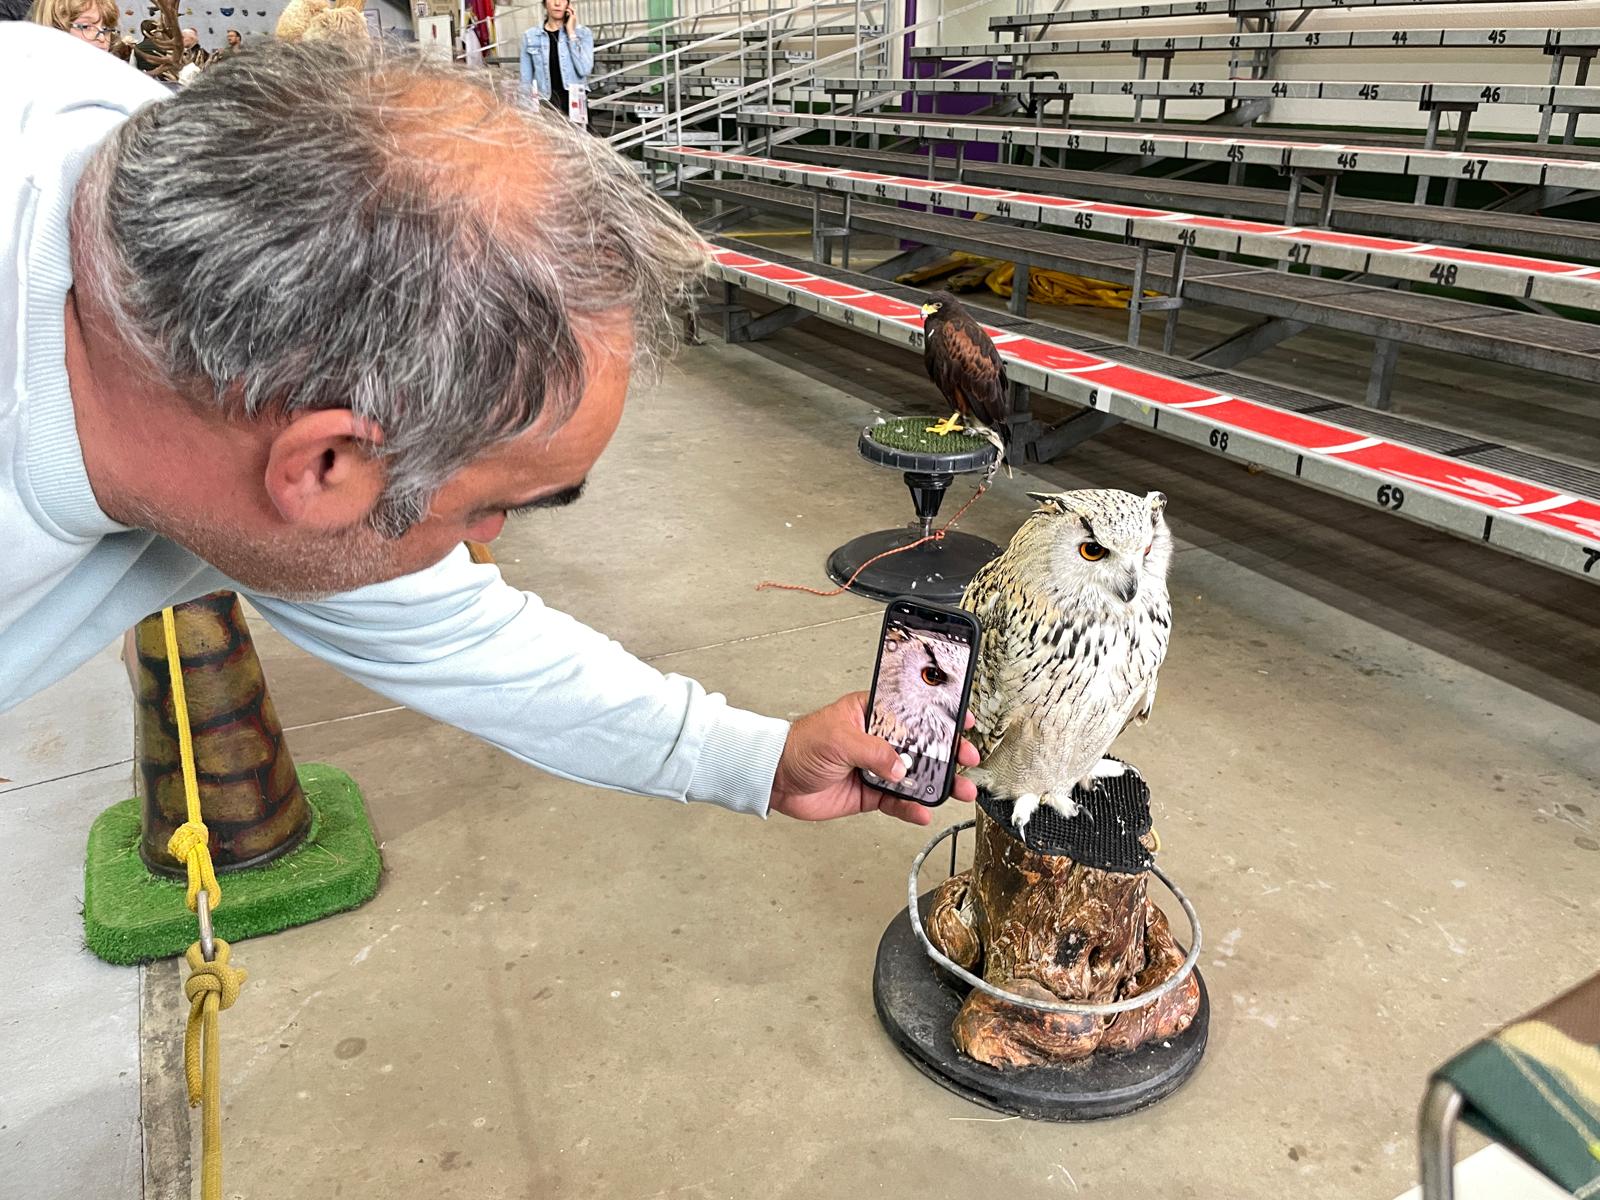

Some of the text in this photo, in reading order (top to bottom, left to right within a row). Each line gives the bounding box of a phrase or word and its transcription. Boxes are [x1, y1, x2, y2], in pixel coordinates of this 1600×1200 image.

[1195, 2, 1207, 13] 40
[1165, 38, 1175, 50] 41
[1229, 36, 1240, 47] 42
[1305, 33, 1320, 46] 43
[1392, 31, 1407, 45] 44
[1488, 30, 1506, 44] 45
[1058, 82, 1067, 93] 41
[1121, 82, 1133, 94] 42
[1189, 82, 1205, 96] 43
[1271, 82, 1287, 98] 44
[1358, 84, 1379, 100] 45
[1480, 86, 1500, 103] 46
[1002, 131, 1012, 143] 42
[1067, 135, 1080, 149] 43
[1140, 140, 1155, 155] 44
[1227, 144, 1245, 162] 45
[1337, 153, 1358, 169] 46
[1462, 160, 1488, 179] 47
[875, 184, 886, 197] 42
[930, 192, 942, 205] 43
[997, 201, 1010, 217] 44
[1075, 212, 1093, 229] 45
[1178, 229, 1196, 246] 46
[1288, 243, 1311, 263] 47
[1430, 263, 1458, 285] 48
[909, 331, 924, 347] 45
[1089, 389, 1097, 406] 6
[1209, 428, 1228, 451] 68
[1376, 484, 1404, 511] 69
[1582, 547, 1600, 573] 7
